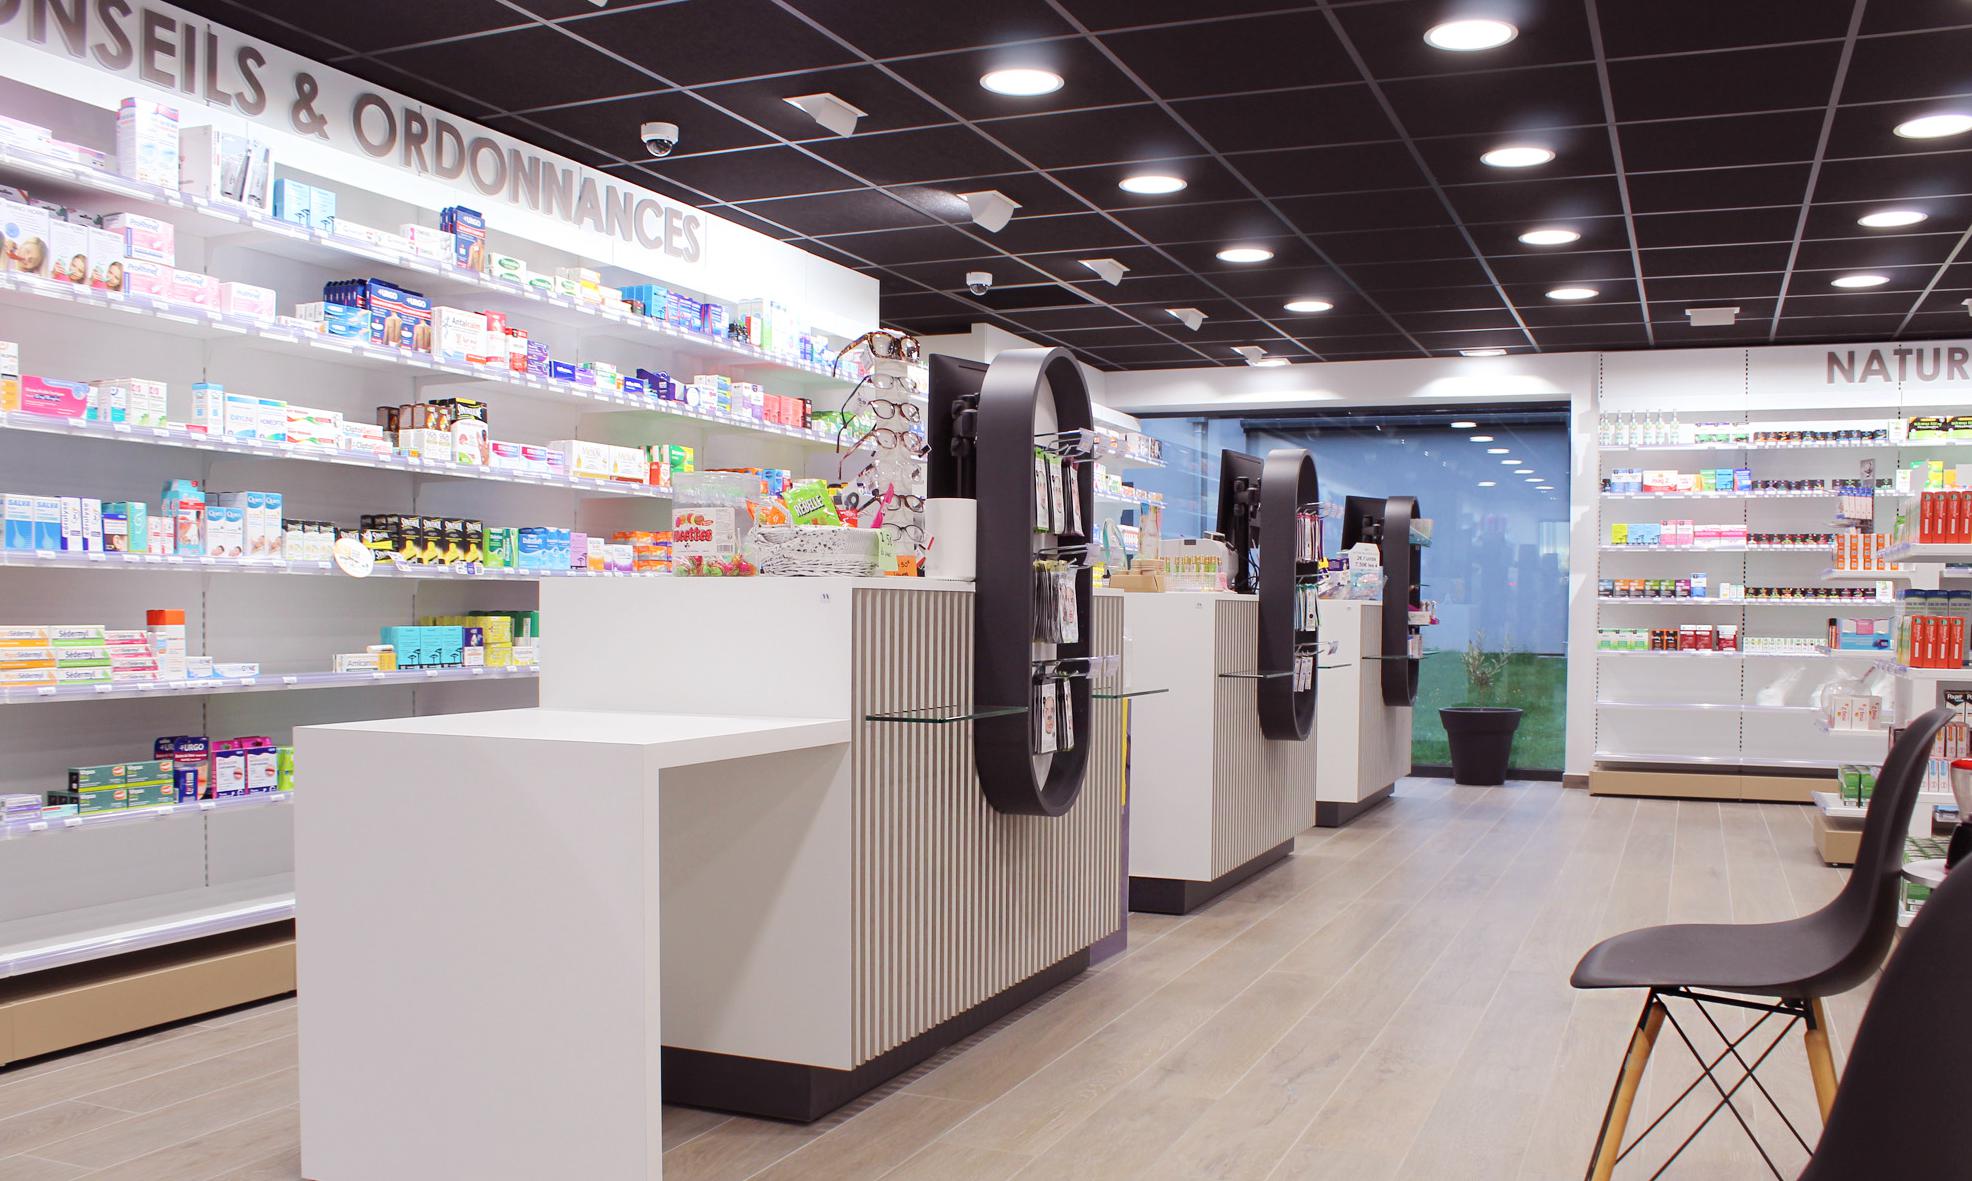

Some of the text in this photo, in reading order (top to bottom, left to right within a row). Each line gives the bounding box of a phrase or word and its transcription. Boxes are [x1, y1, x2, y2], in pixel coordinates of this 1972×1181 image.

[0, 0, 701, 263] NSEILS & ORDONNANCES
[1827, 347, 1970, 384] NATUR
[184, 743, 205, 752] URGO
